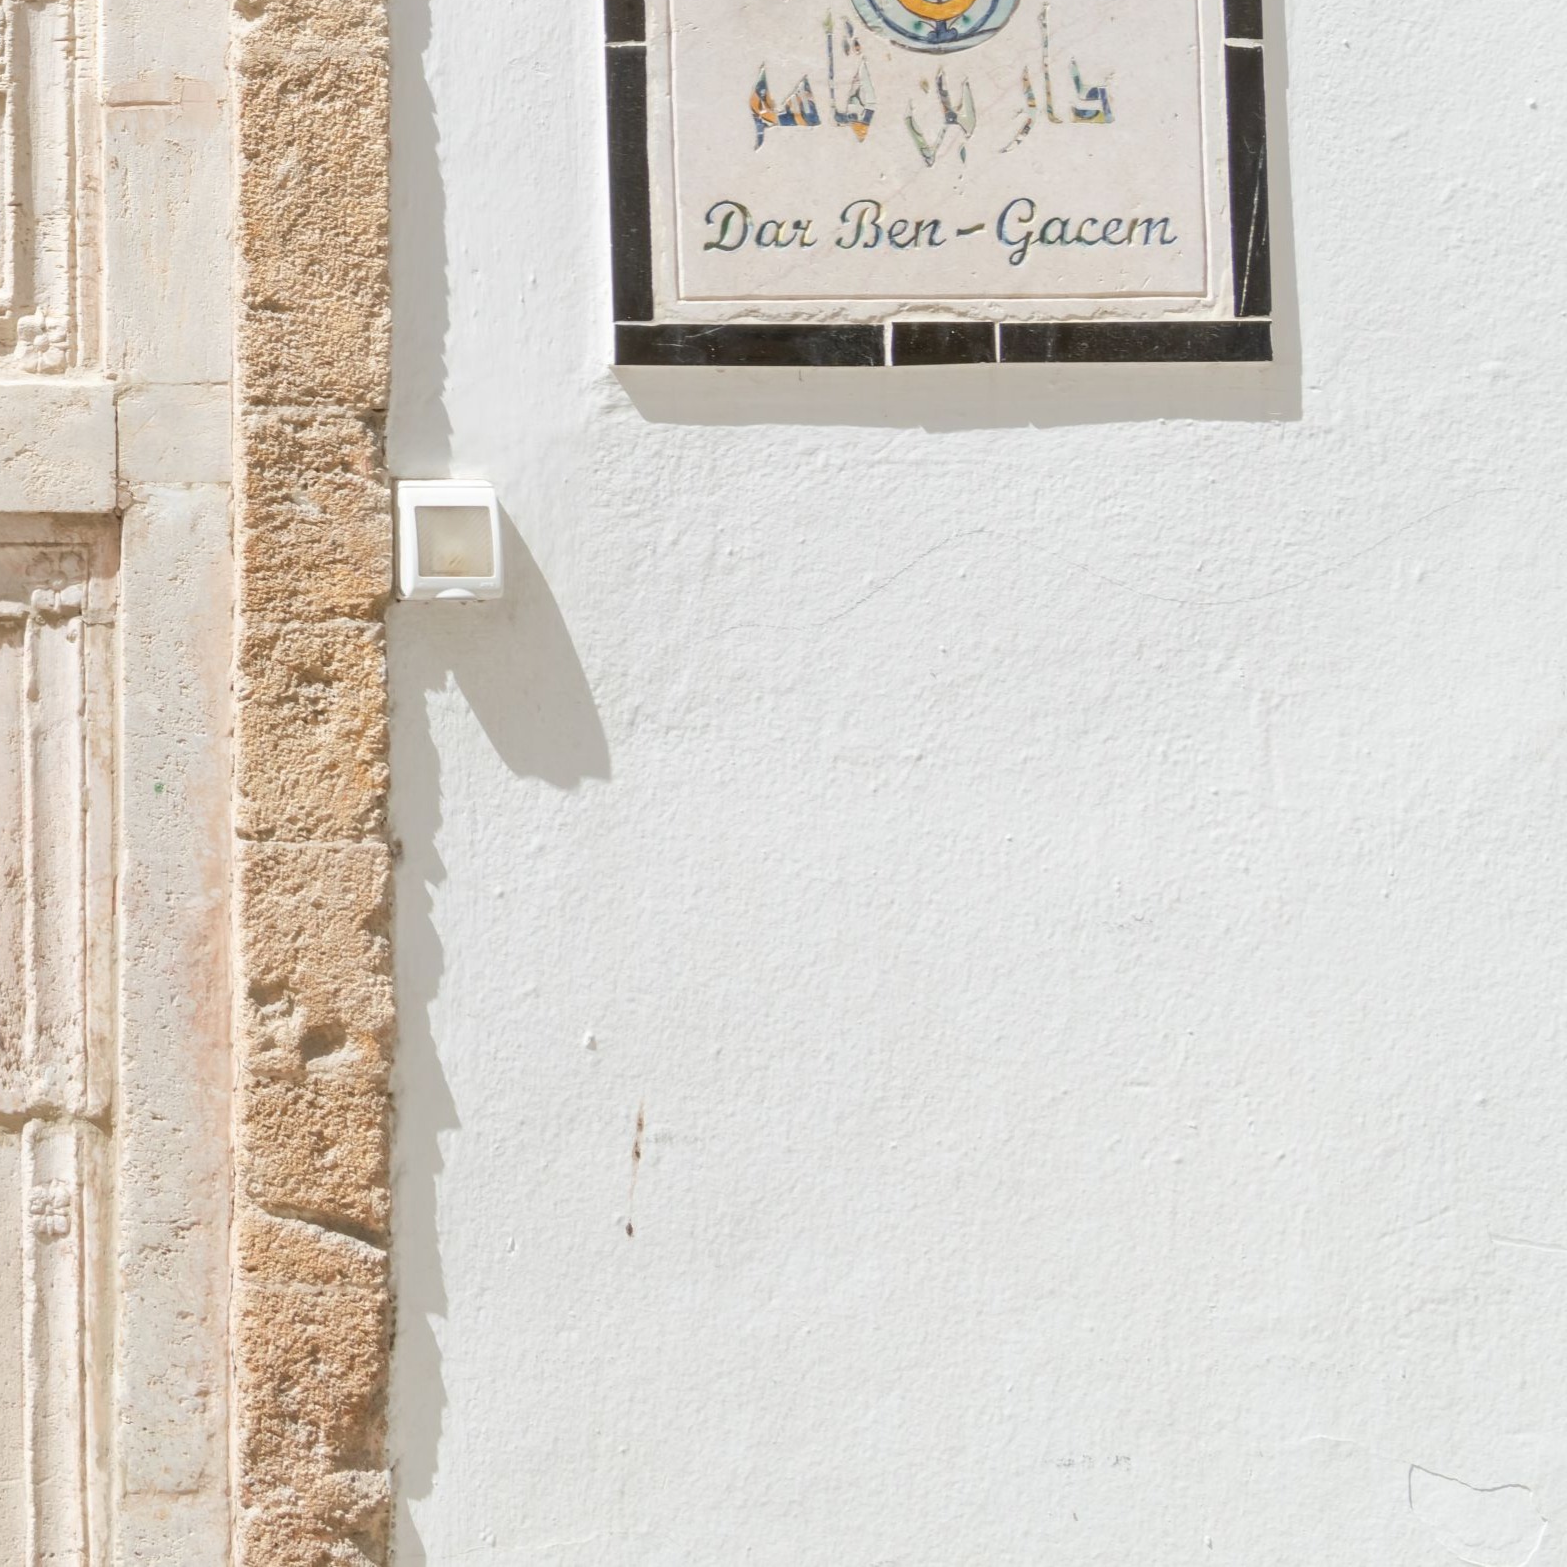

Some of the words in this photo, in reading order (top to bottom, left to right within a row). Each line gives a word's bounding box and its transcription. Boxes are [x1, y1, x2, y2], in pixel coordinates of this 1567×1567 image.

[906, 65, 977, 168] بن
[998, 2, 1115, 153] دار
[704, 200, 818, 252] Dar
